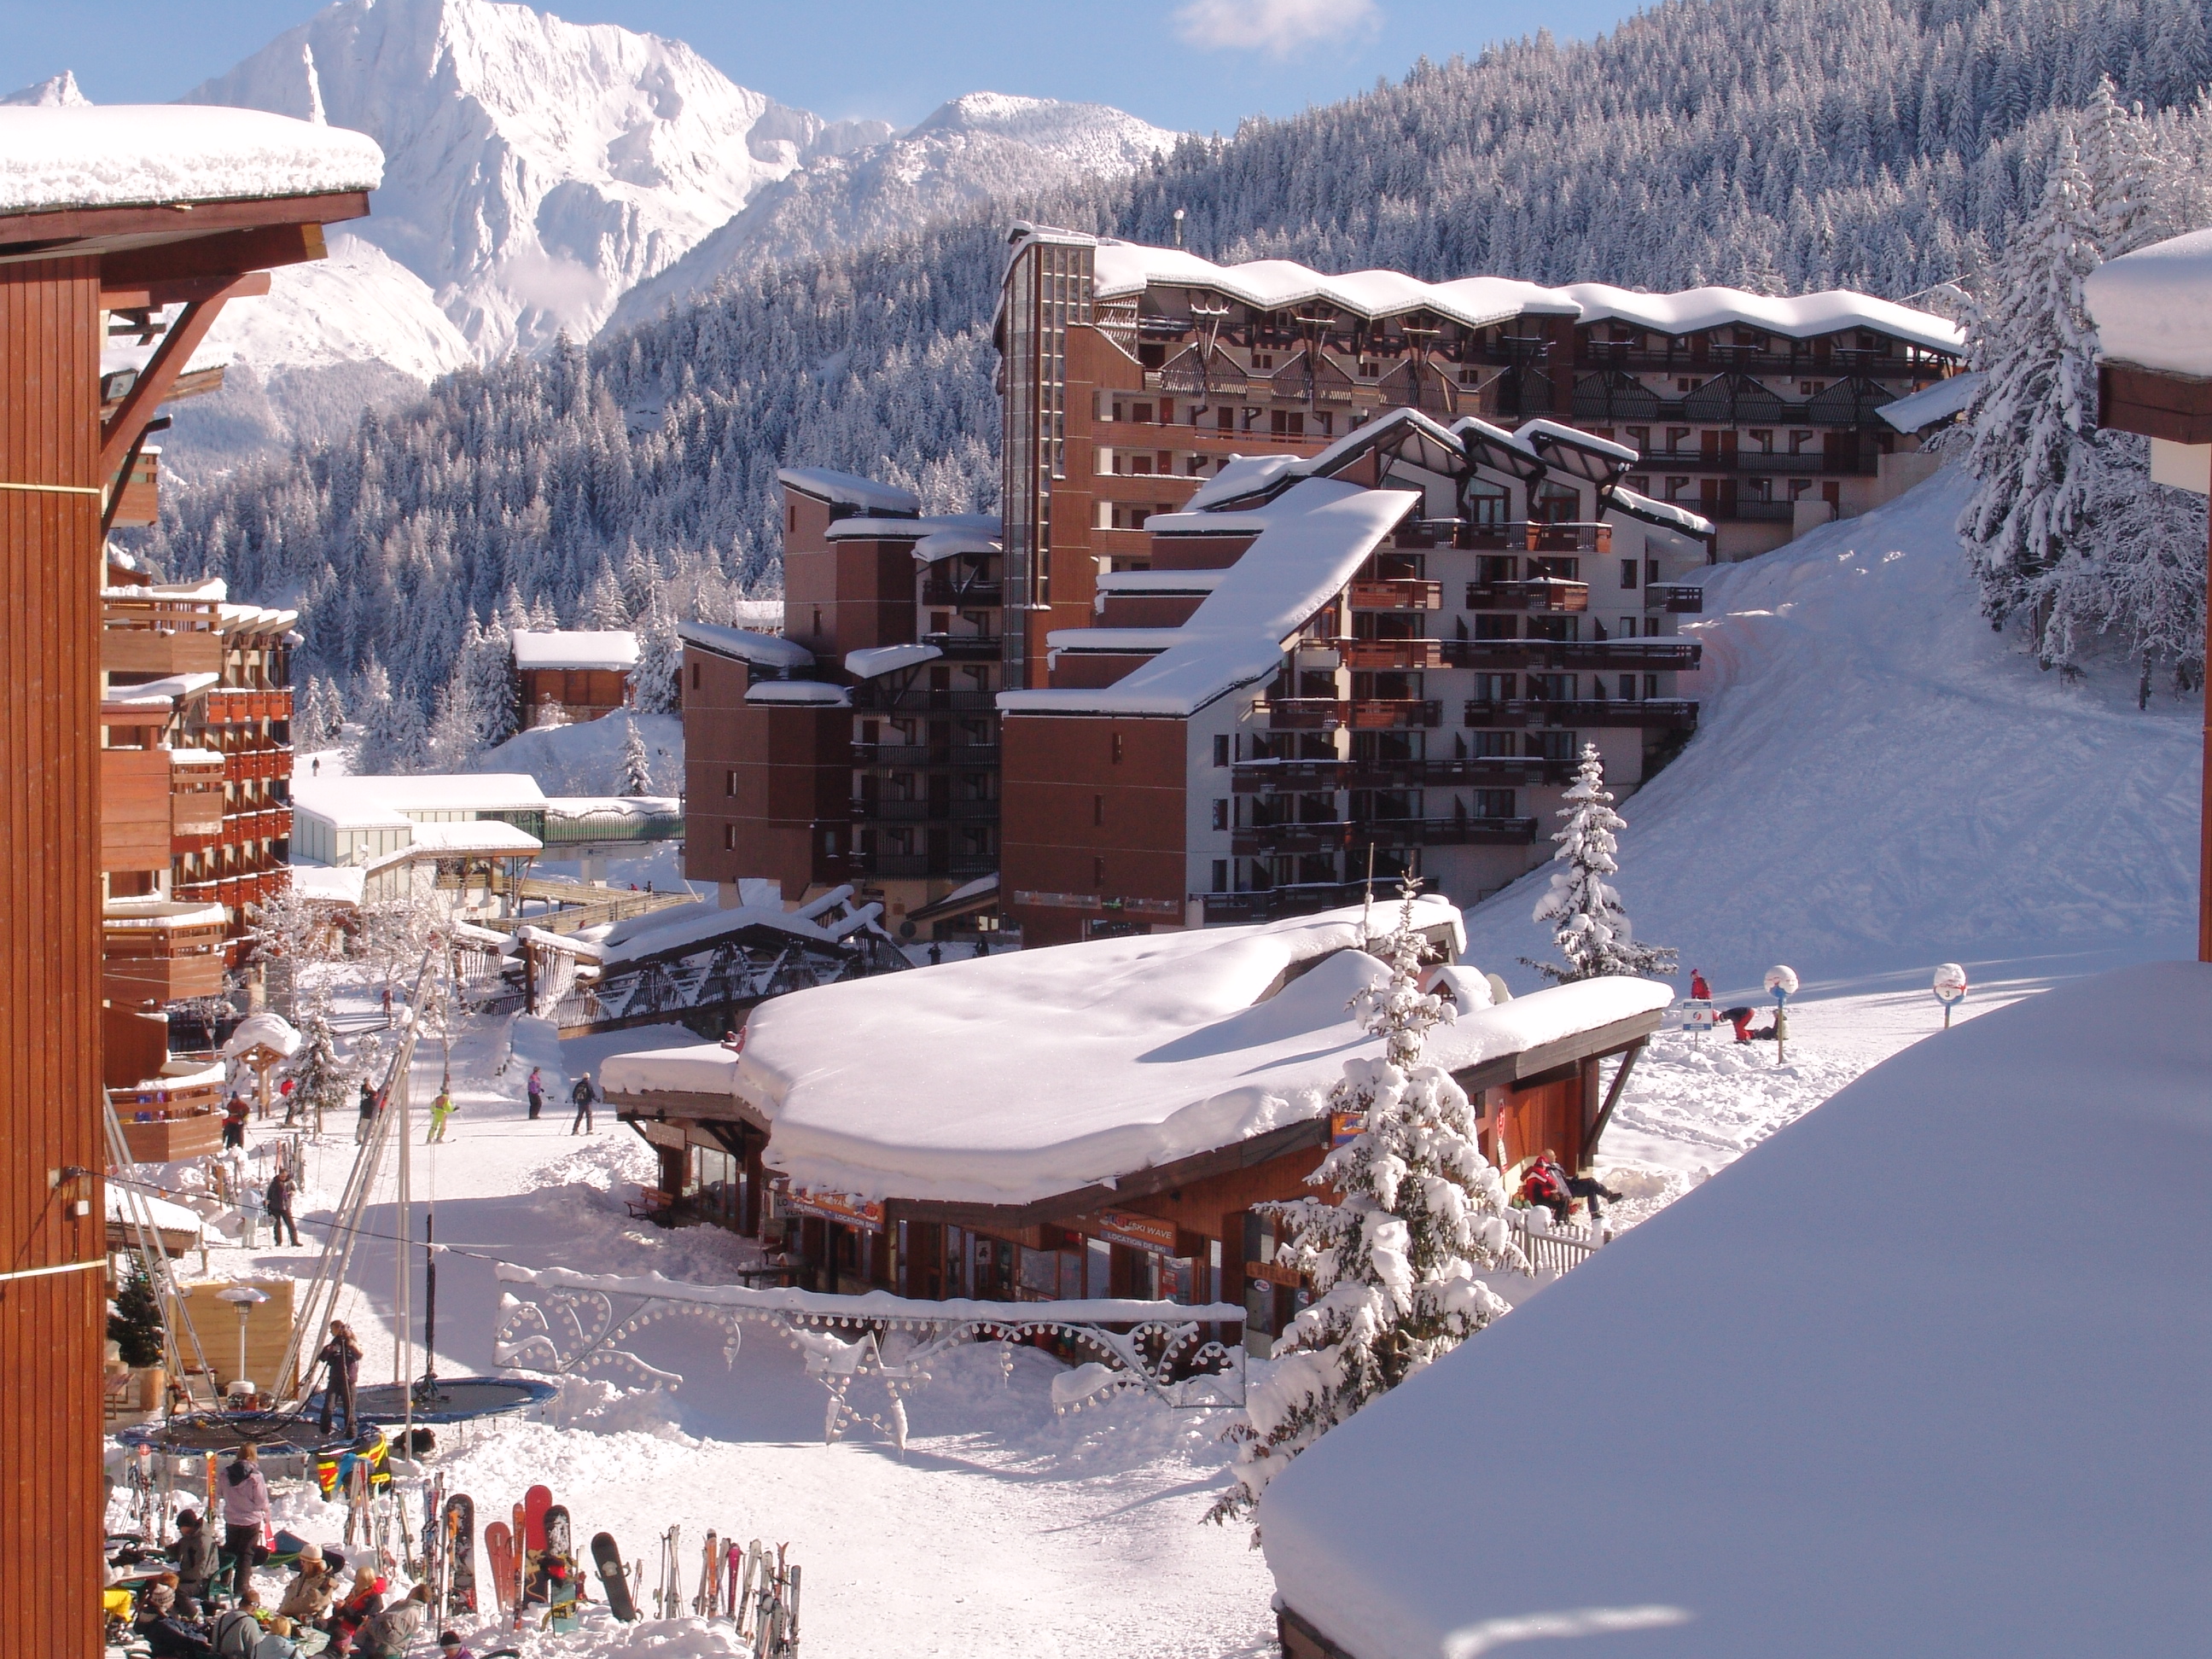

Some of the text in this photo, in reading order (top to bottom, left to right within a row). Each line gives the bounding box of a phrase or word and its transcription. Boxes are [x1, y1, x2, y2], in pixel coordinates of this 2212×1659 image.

[794, 1202, 876, 1229] SKI RENTAL LOCATION SKI
[1132, 1222, 1173, 1239] SKI WAVE
[1107, 1232, 1142, 1247] LOCATION
[1155, 1245, 1166, 1254] SKI
